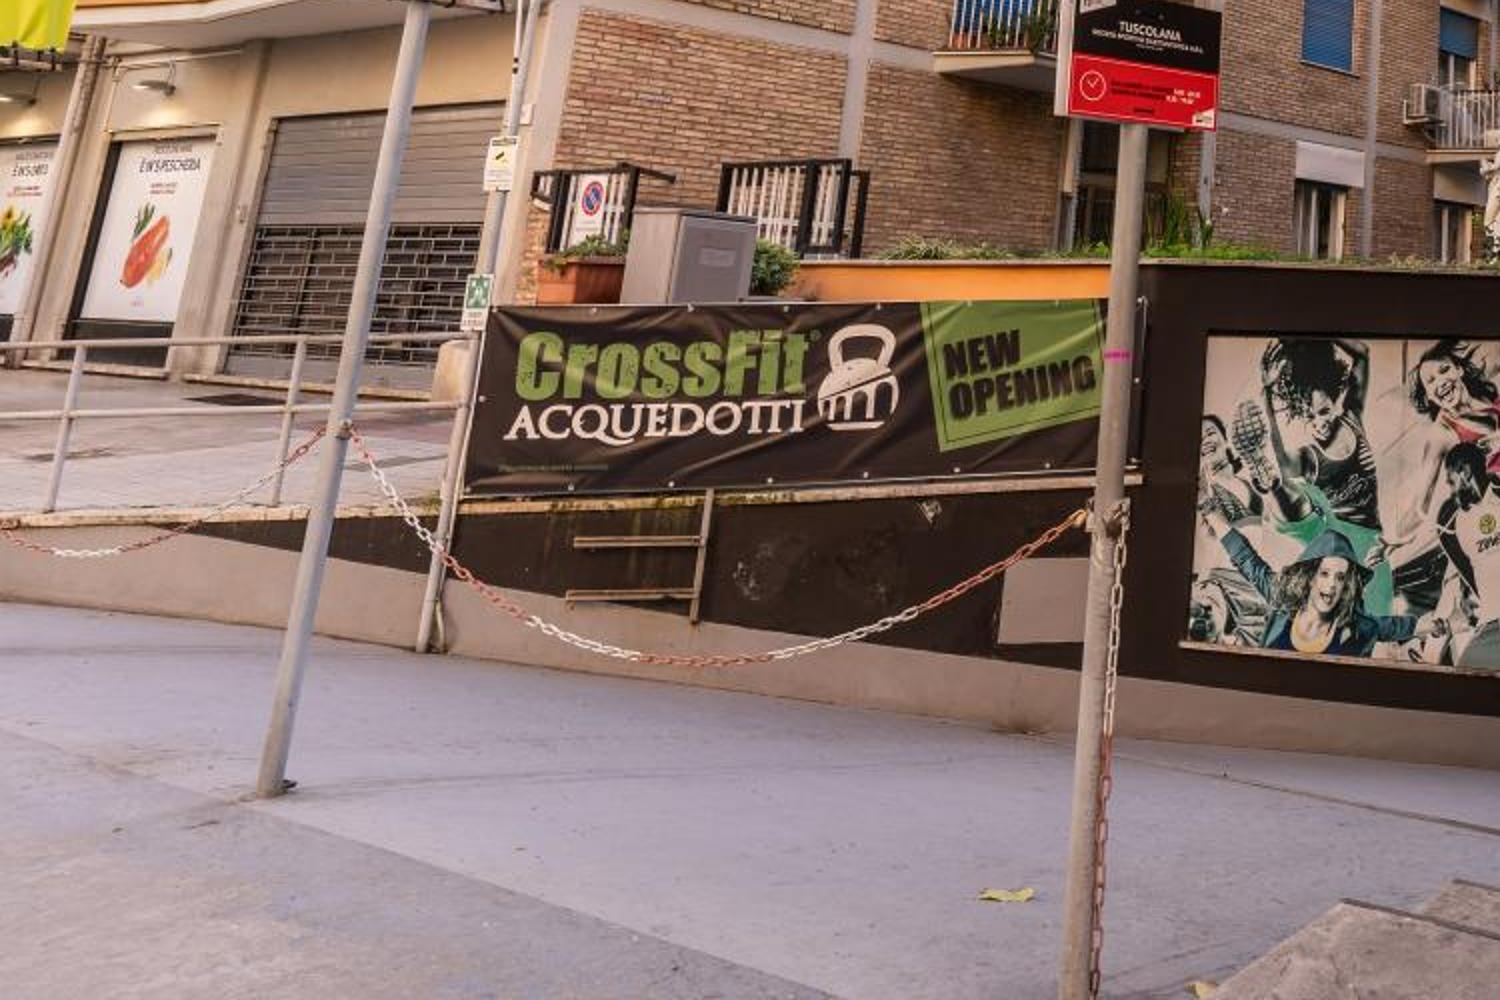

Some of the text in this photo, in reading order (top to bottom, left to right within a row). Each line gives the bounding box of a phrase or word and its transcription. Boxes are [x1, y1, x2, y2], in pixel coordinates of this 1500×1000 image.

[1119, 21, 1182, 42] TUSCOLANA
[515, 330, 809, 400] CrossFit
[943, 329, 1021, 379] NEW
[949, 355, 1096, 420] OPENING
[503, 400, 806, 446] ACQUEDOTTI
